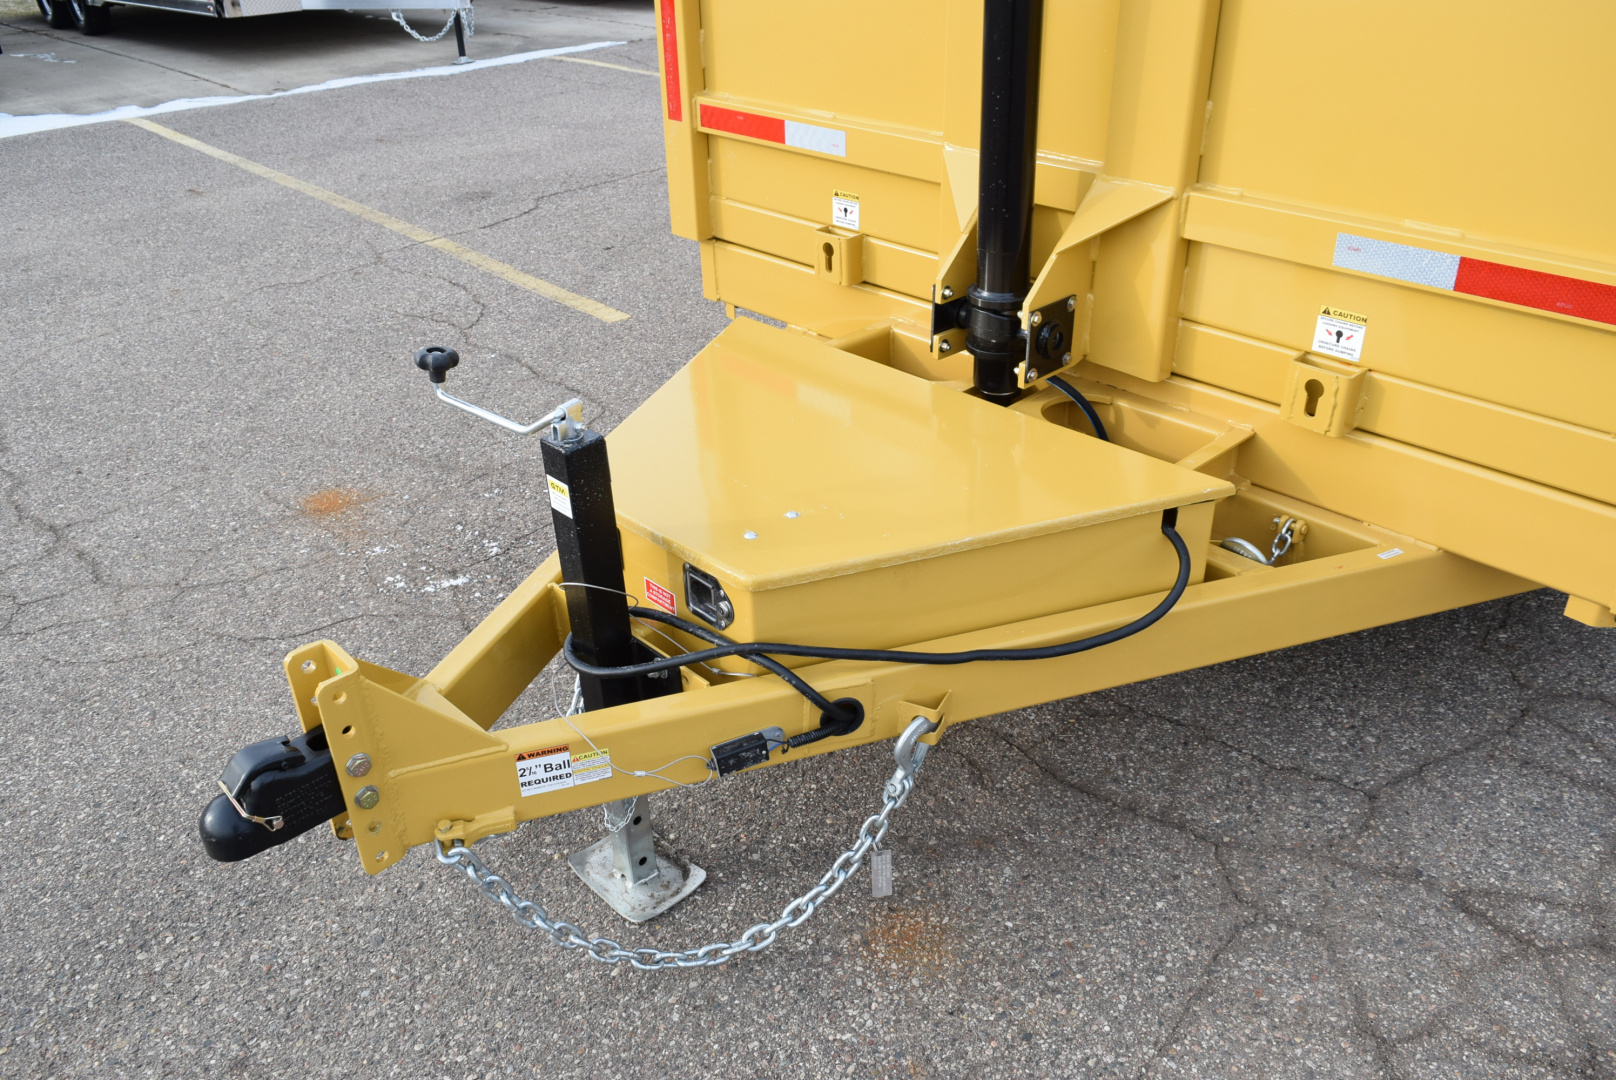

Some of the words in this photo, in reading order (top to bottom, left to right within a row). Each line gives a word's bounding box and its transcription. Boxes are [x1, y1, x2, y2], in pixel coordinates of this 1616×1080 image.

[840, 192, 859, 200] CAUTION
[1333, 310, 1367, 323] CAUTION
[527, 746, 569, 758] WARNING
[544, 759, 571, 773] Ball
[520, 772, 572, 788] REQUIRED
